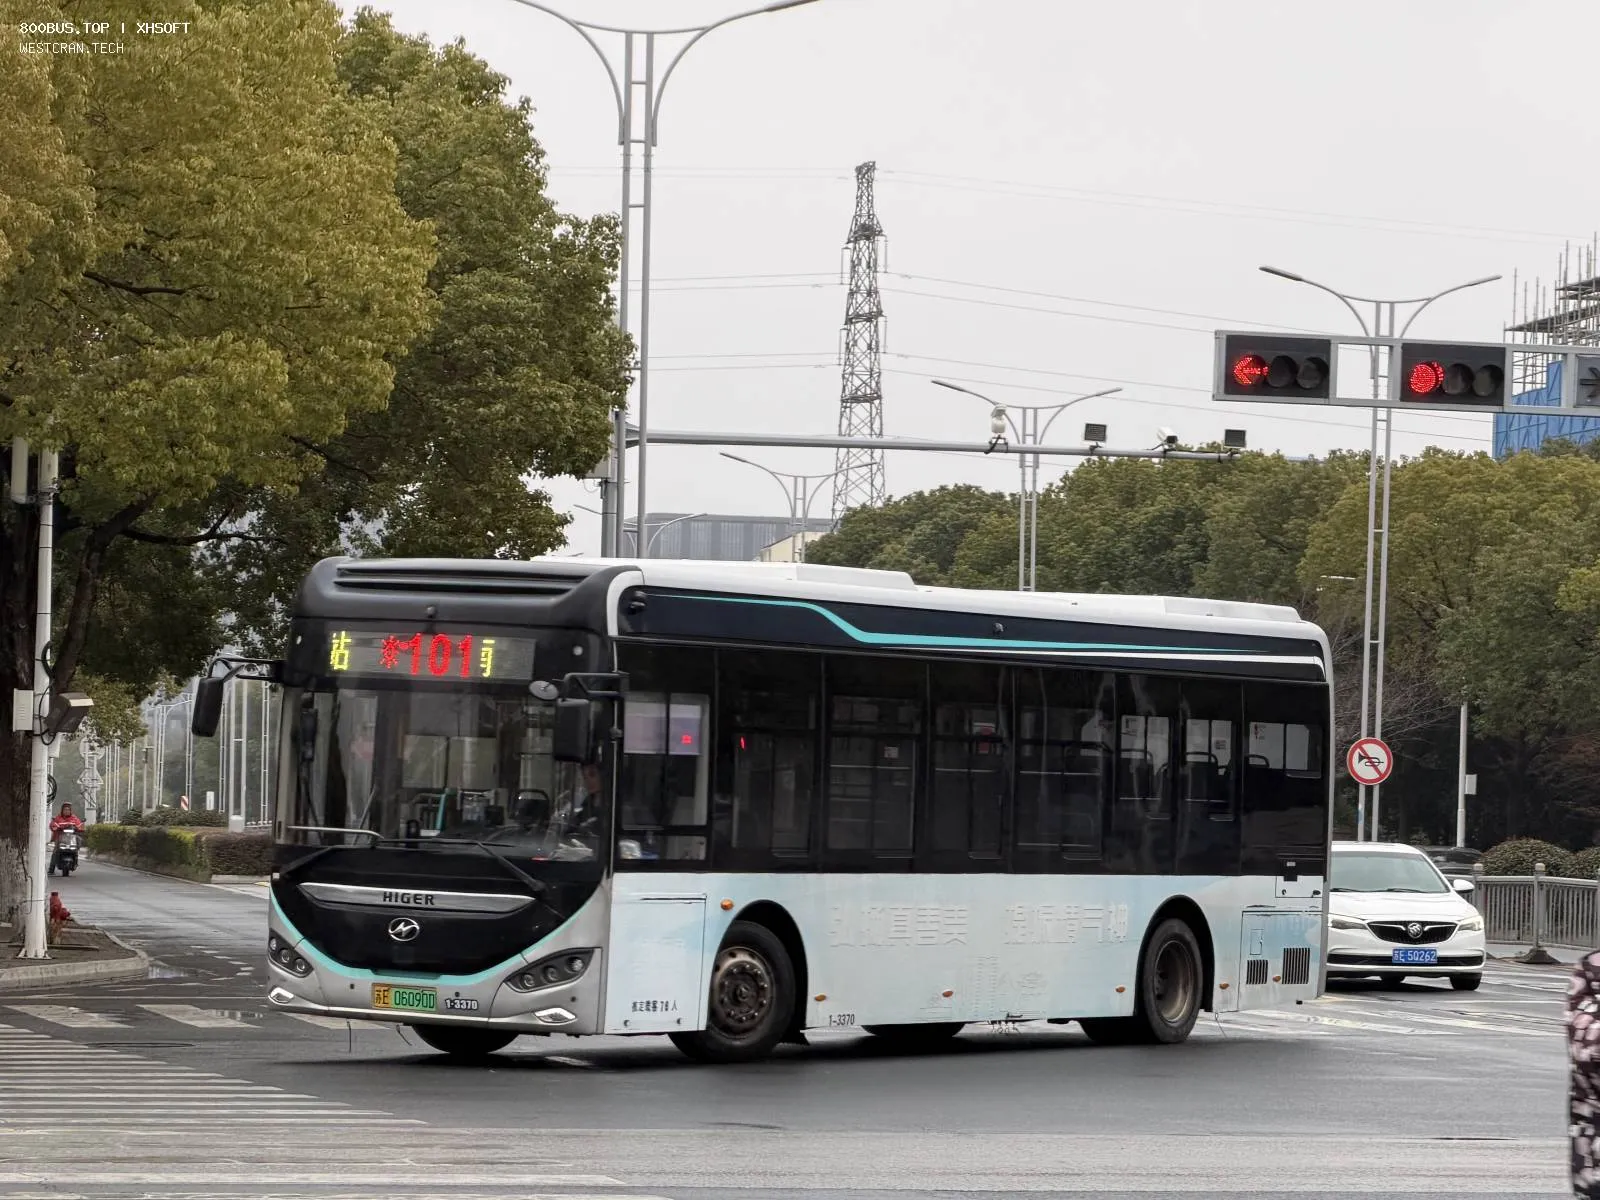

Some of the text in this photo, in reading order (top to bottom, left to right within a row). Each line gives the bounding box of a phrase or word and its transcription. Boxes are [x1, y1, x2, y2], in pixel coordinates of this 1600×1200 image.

[382, 891, 435, 906] HIGER
[393, 990, 436, 1009] 06090D
[829, 1013, 855, 1027] 1-3370
